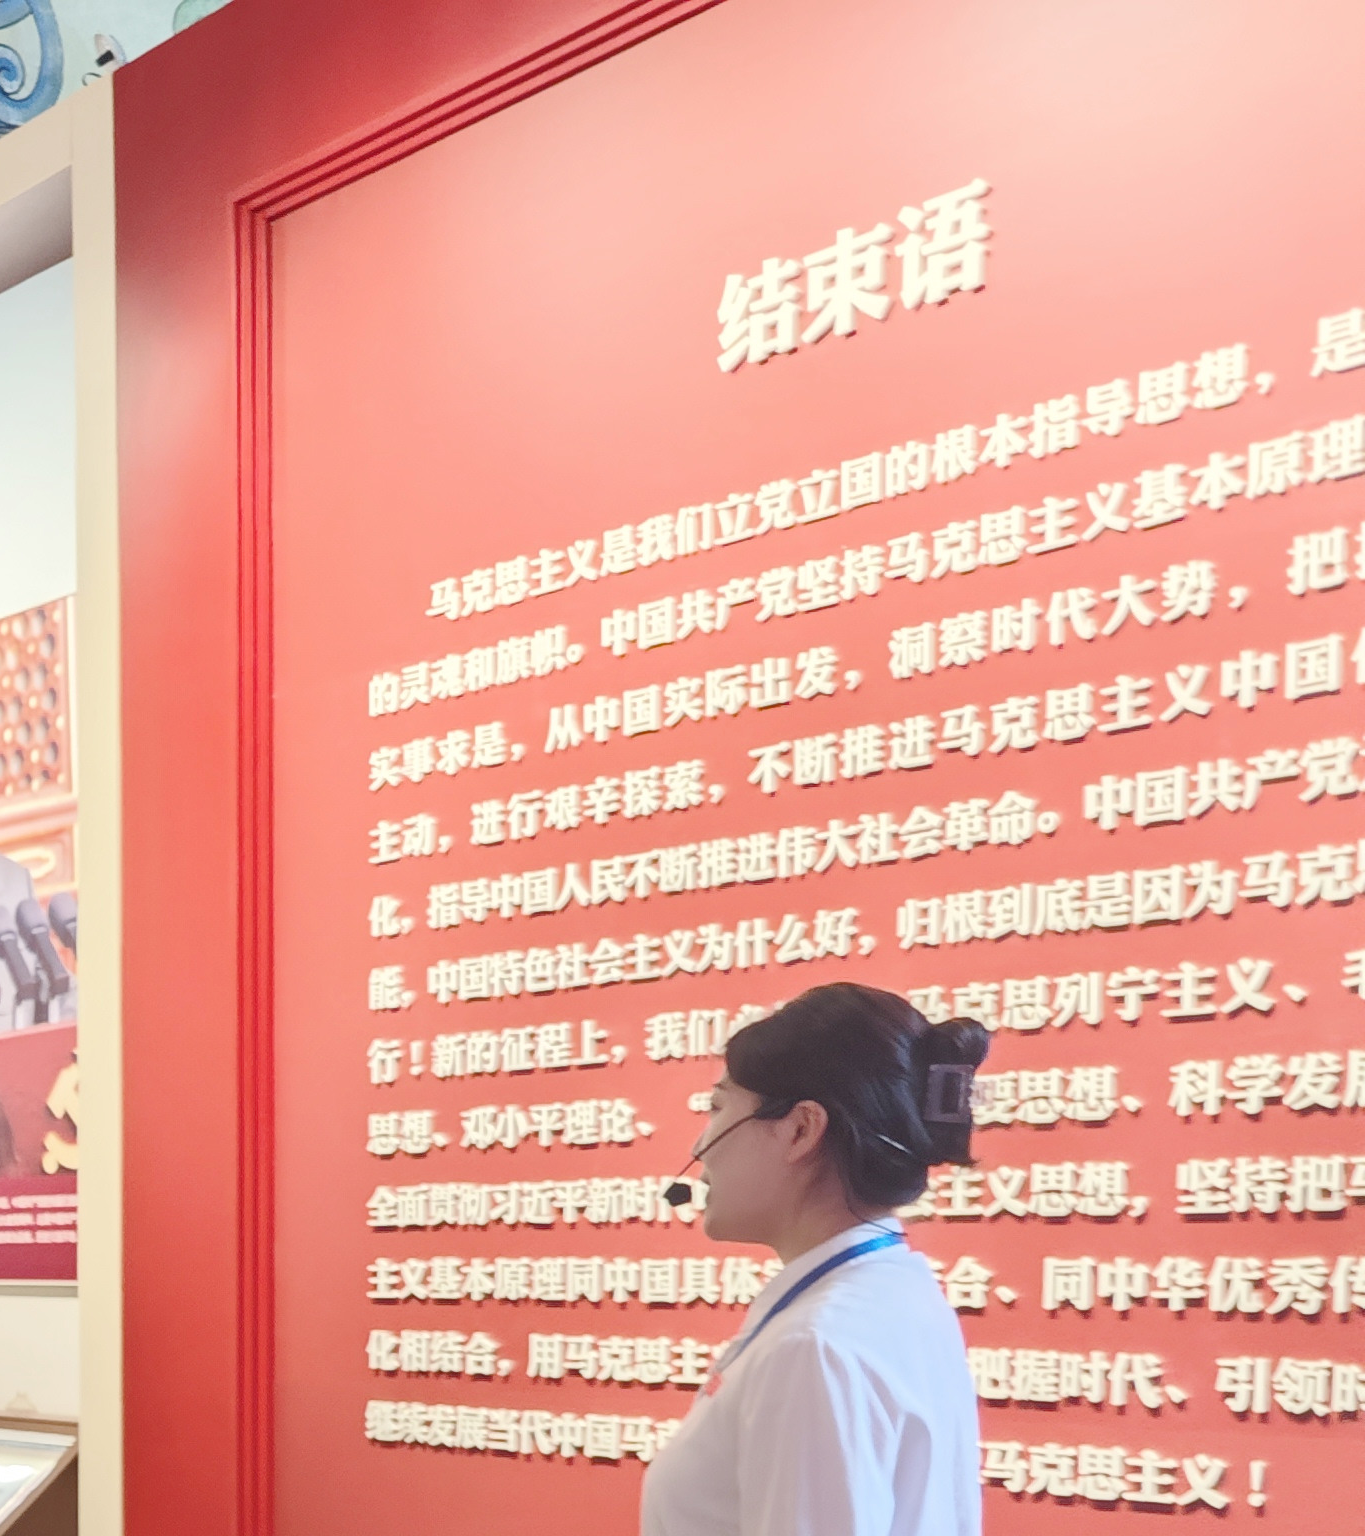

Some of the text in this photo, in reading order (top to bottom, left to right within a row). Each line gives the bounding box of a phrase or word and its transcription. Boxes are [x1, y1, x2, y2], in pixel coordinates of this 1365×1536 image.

[716, 179, 992, 373] 结束语
[368, 523, 1365, 791] 实事求是，从中国实际出发，洞察时代大势，把
[368, 736, 1365, 937] 化，指导中国人民不断推进伟大社会革命。中国共产党
[368, 841, 1365, 1011] 能，中国特色社会主义为什么好，归根到底是因为马克
[366, 1329, 727, 1386] 化相结合，用马克思主
